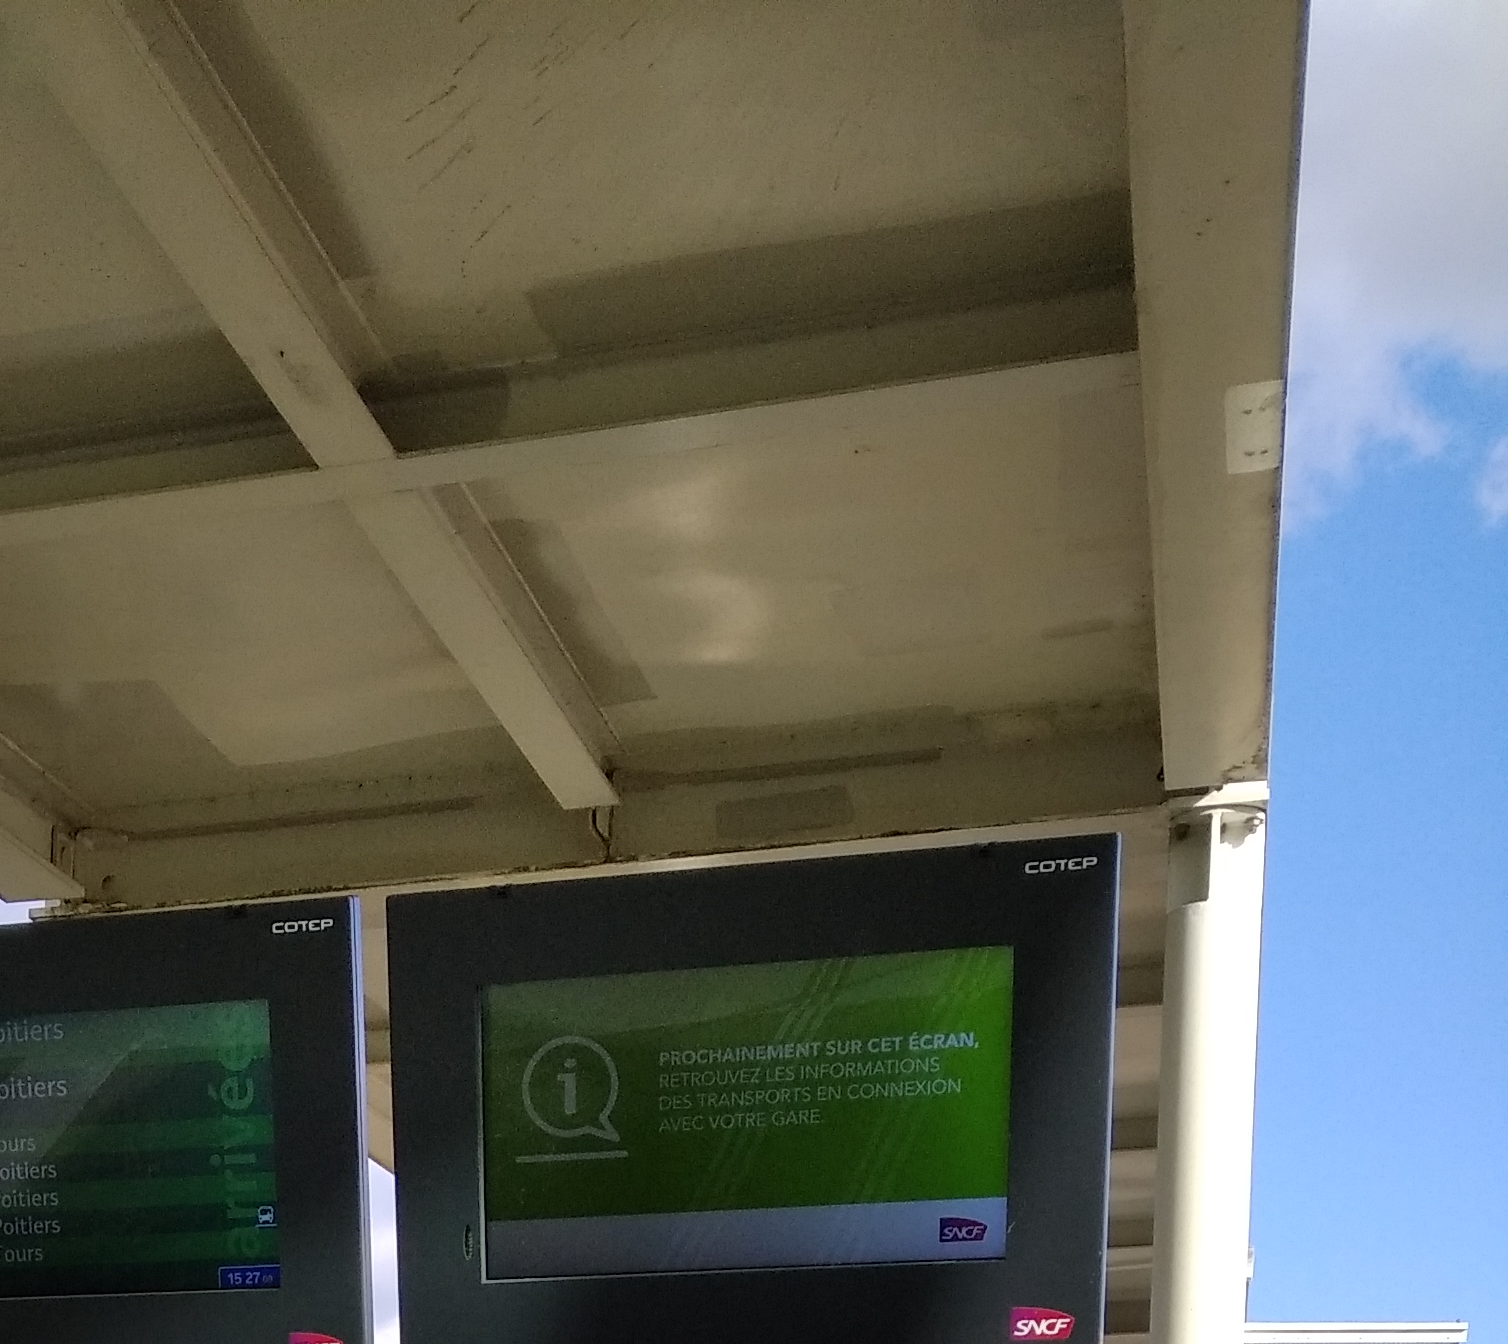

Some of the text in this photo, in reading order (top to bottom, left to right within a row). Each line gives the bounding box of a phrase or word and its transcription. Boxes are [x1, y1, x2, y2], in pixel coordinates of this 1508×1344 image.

[1024, 856, 1098, 875] COTEP
[271, 918, 335, 933] COTEP
[659, 1030, 981, 1067] PROCHAINEMENT SUR CET ÉCRAN,
[659, 1056, 941, 1088] RETROUVEZ LES INFORMATIONS
[659, 1077, 962, 1110] DES TRANSPORTS EN CONNEXION
[659, 1114, 704, 1133] AVEC
[709, 1111, 766, 1130] VOTRE
[942, 1225, 984, 1241] SNCF
[227, 1271, 261, 1286] 15 27
[1012, 1316, 1070, 1338] SNCF
